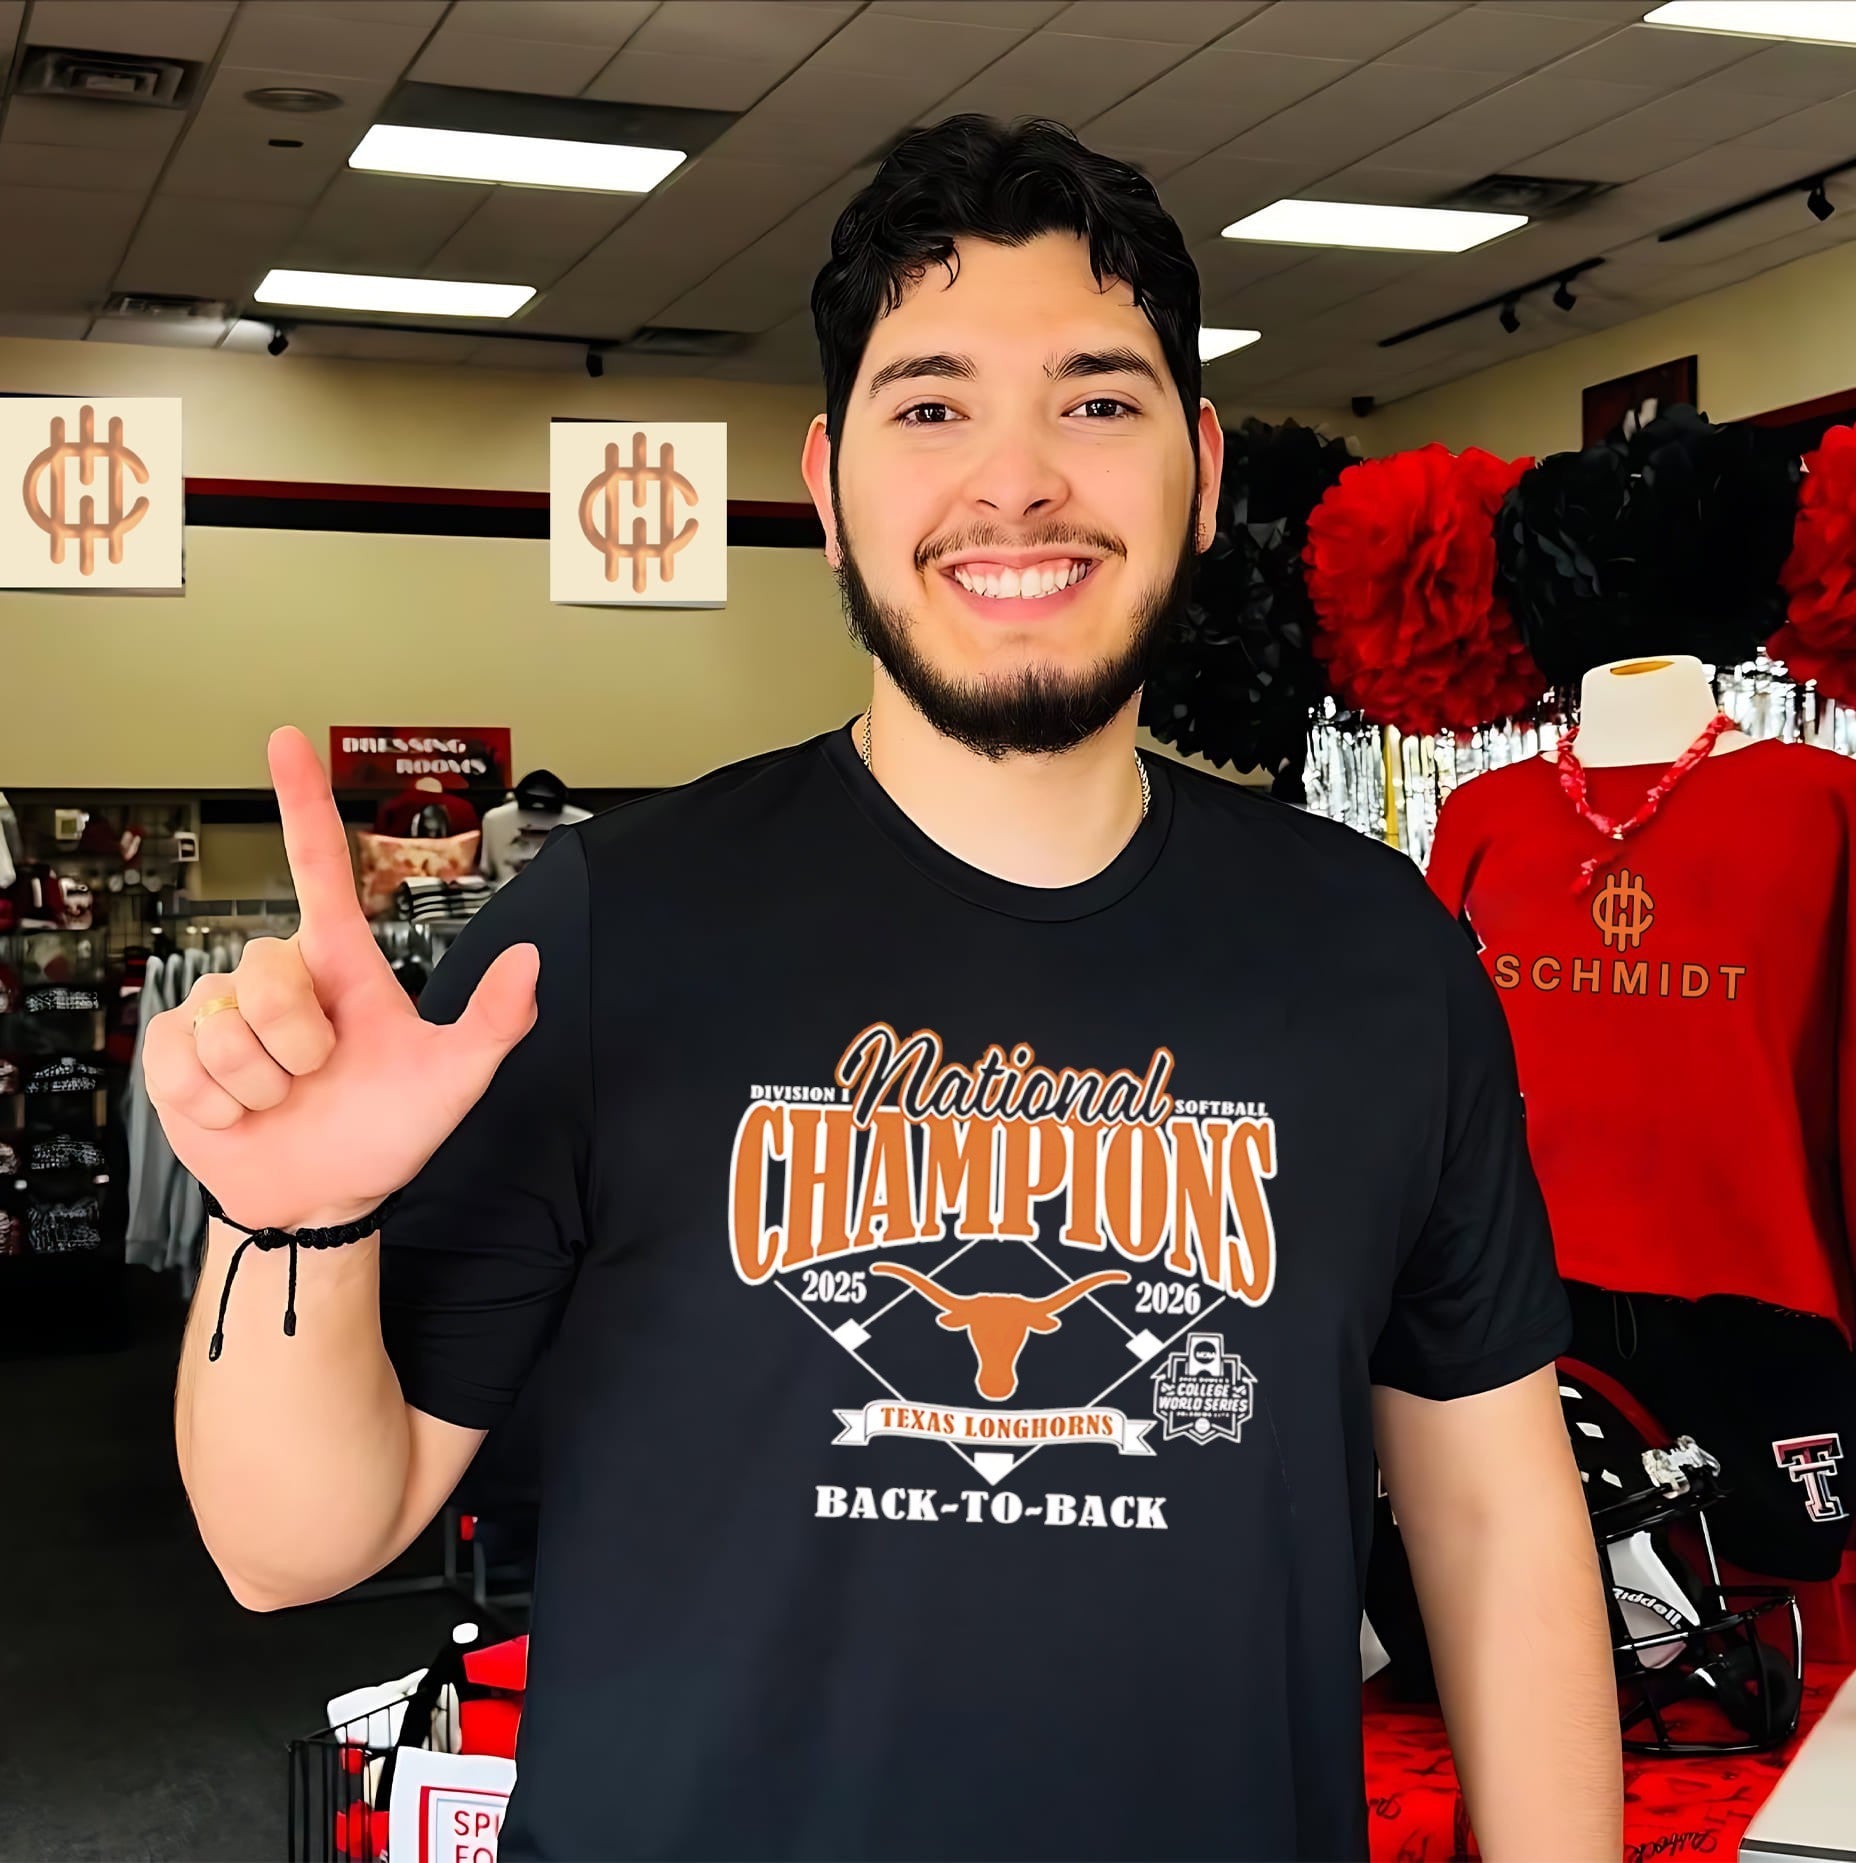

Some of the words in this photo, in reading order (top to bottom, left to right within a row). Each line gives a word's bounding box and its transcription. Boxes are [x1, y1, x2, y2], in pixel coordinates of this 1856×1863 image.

[342, 738, 466, 754] DRESSING
[396, 759, 487, 774] ROOMS
[1494, 954, 1746, 1000] SCHMIDT
[834, 1022, 1174, 1130] National
[751, 1084, 835, 1102] DIVISION
[1174, 1099, 1269, 1117] SOFTBALL
[728, 1100, 1277, 1308] CHAMPIONS
[801, 1270, 867, 1303] 2025
[1135, 1281, 1201, 1315] 2026
[1159, 1396, 1202, 1411] WORLD
[1204, 1398, 1248, 1412] SERIES
[1177, 1382, 1230, 1397] COLLEGE
[880, 1406, 955, 1434] TEXAS
[965, 1415, 1113, 1438] LONGHORNS
[814, 1485, 1168, 1529] BACK-TO-BACK
